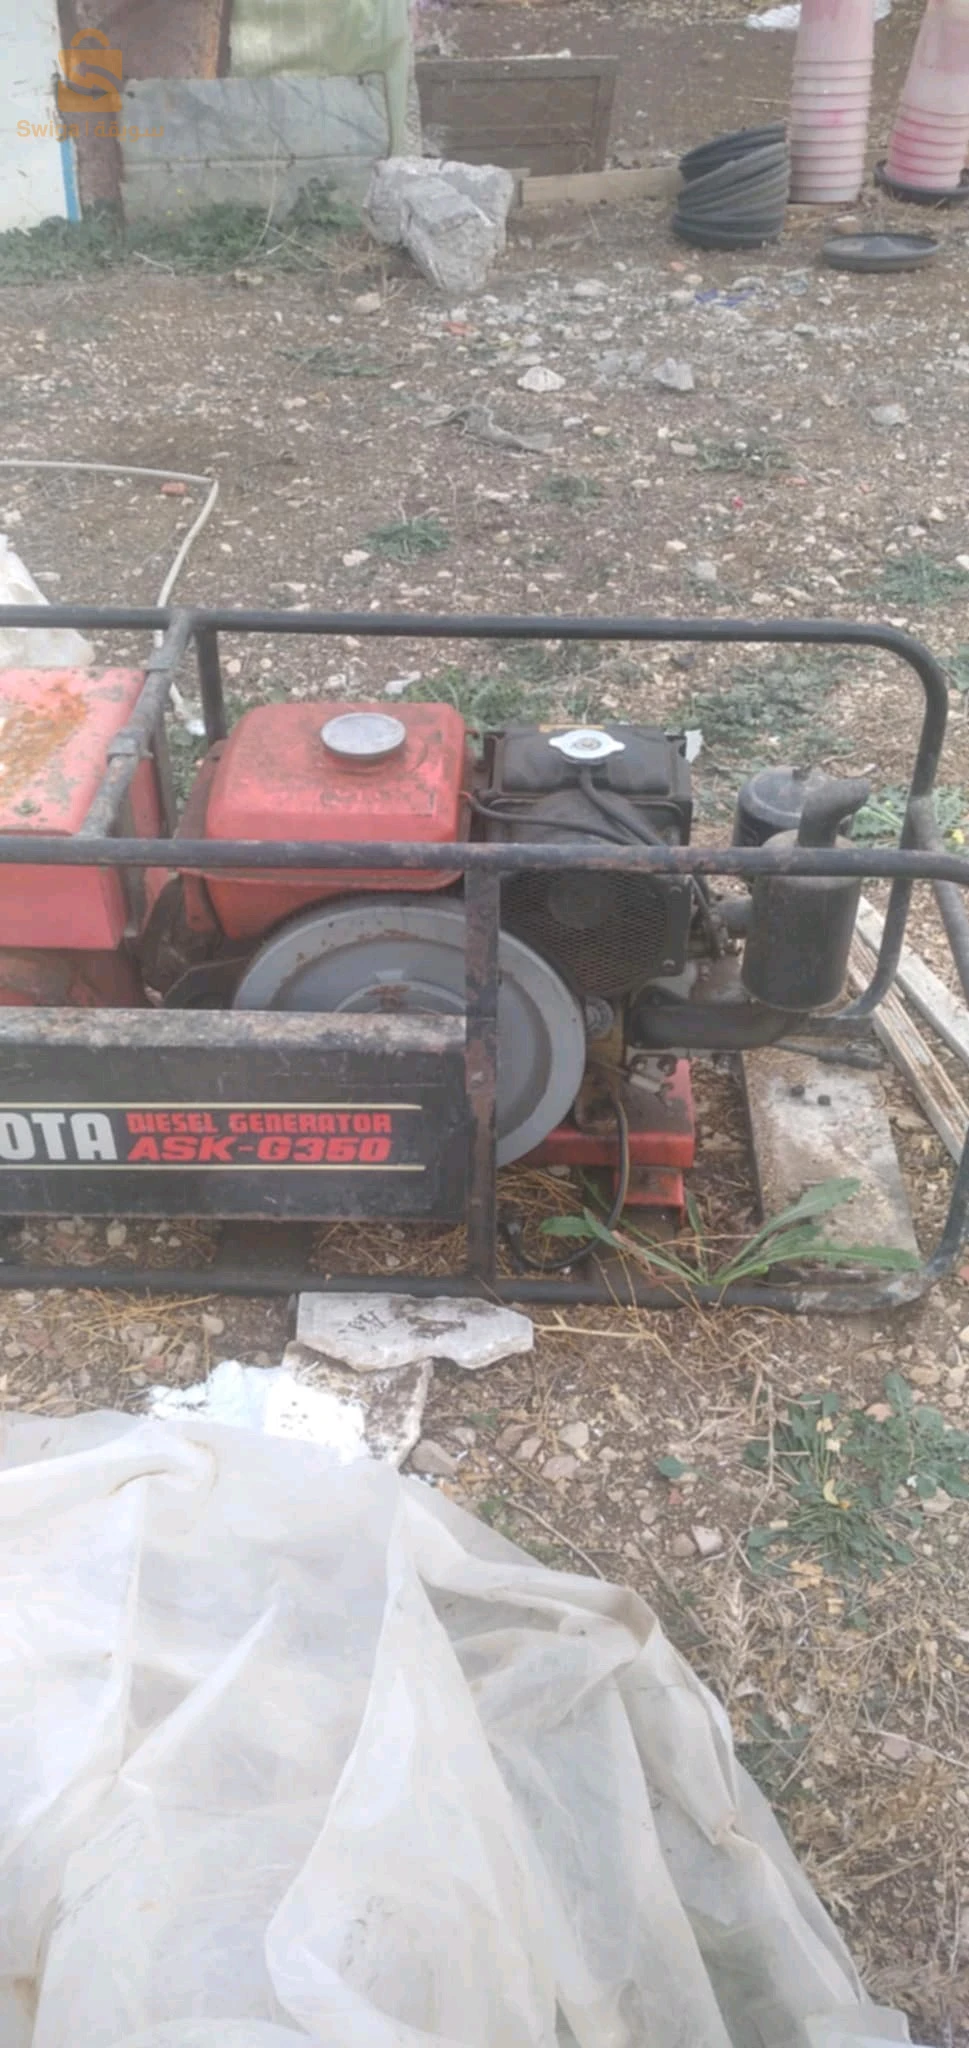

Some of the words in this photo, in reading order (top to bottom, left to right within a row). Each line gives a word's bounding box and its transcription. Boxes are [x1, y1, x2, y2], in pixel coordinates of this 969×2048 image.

[126, 1112, 218, 1134] DIESEL
[229, 1112, 392, 1134] GENERATOR
[127, 1135, 392, 1162] ASK-G350
